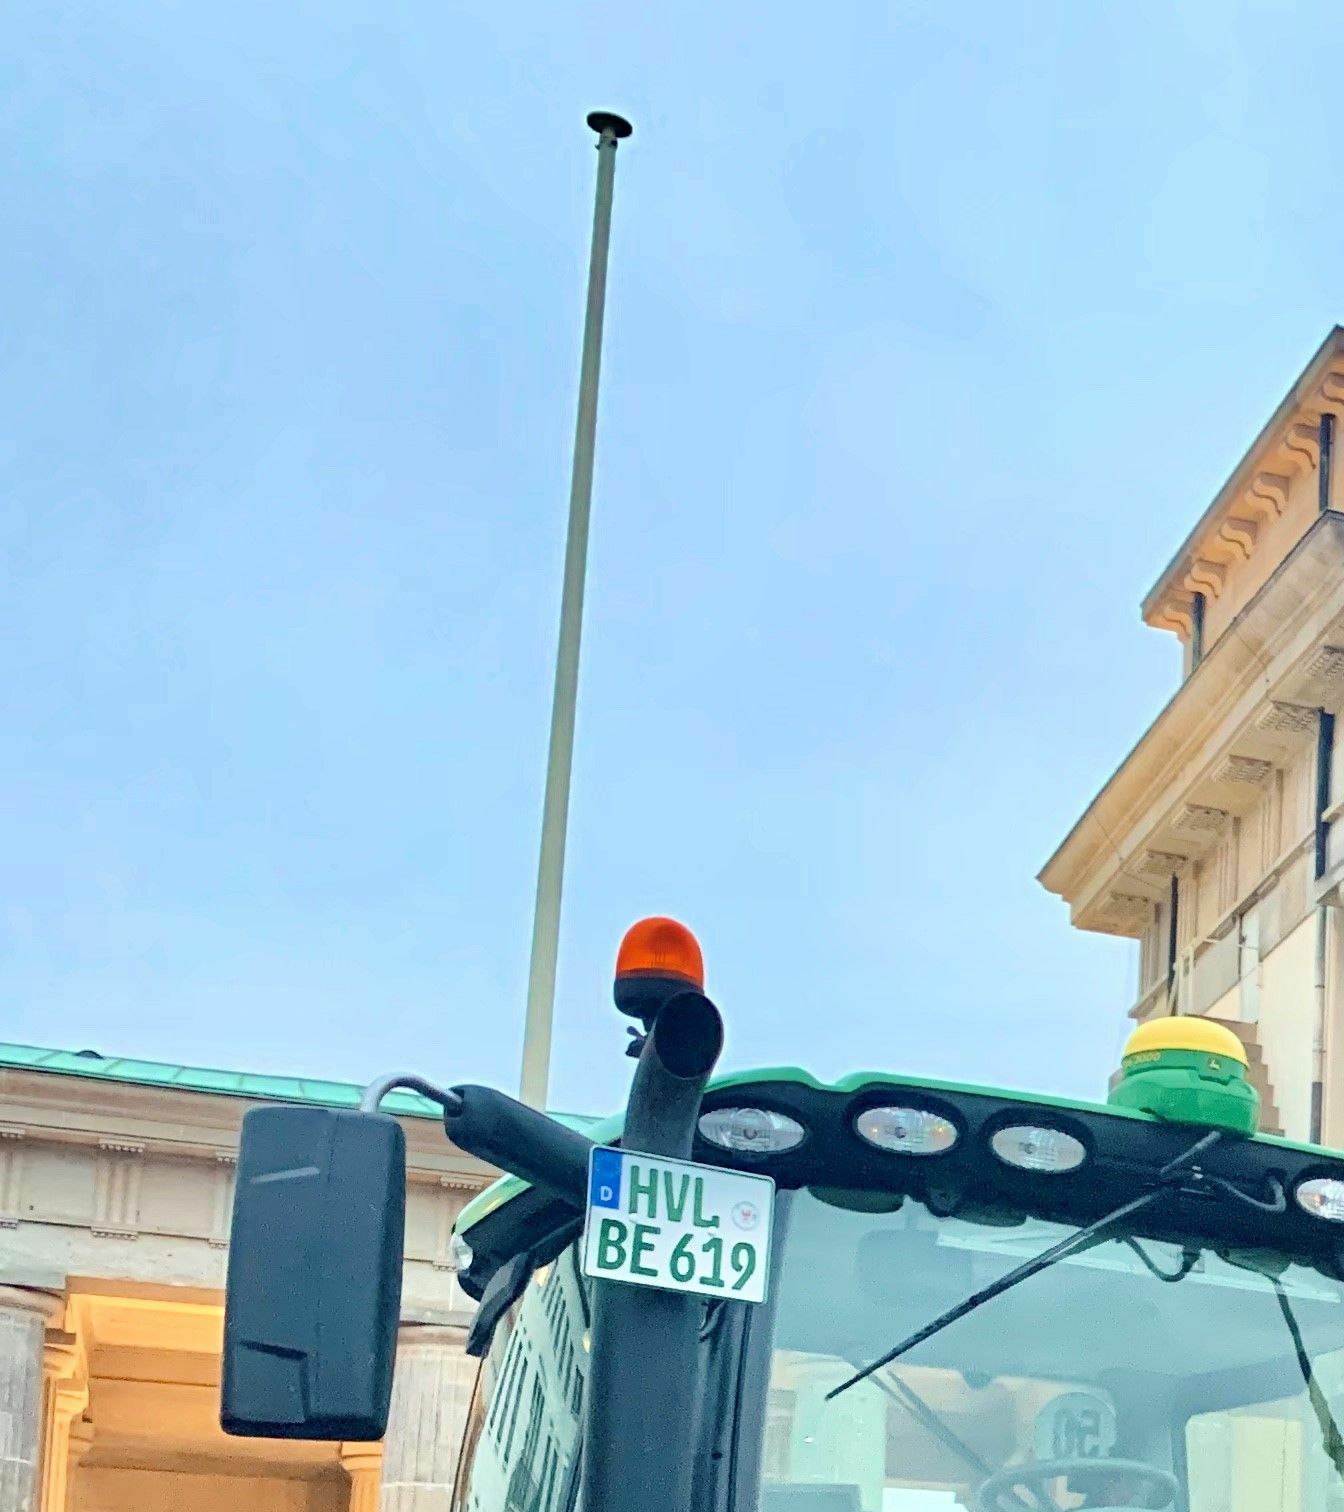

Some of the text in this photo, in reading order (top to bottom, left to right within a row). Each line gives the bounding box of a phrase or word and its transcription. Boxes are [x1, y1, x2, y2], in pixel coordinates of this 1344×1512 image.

[600, 1186, 613, 1201] D
[628, 1165, 720, 1228] HVL
[597, 1218, 756, 1290] BE 619
